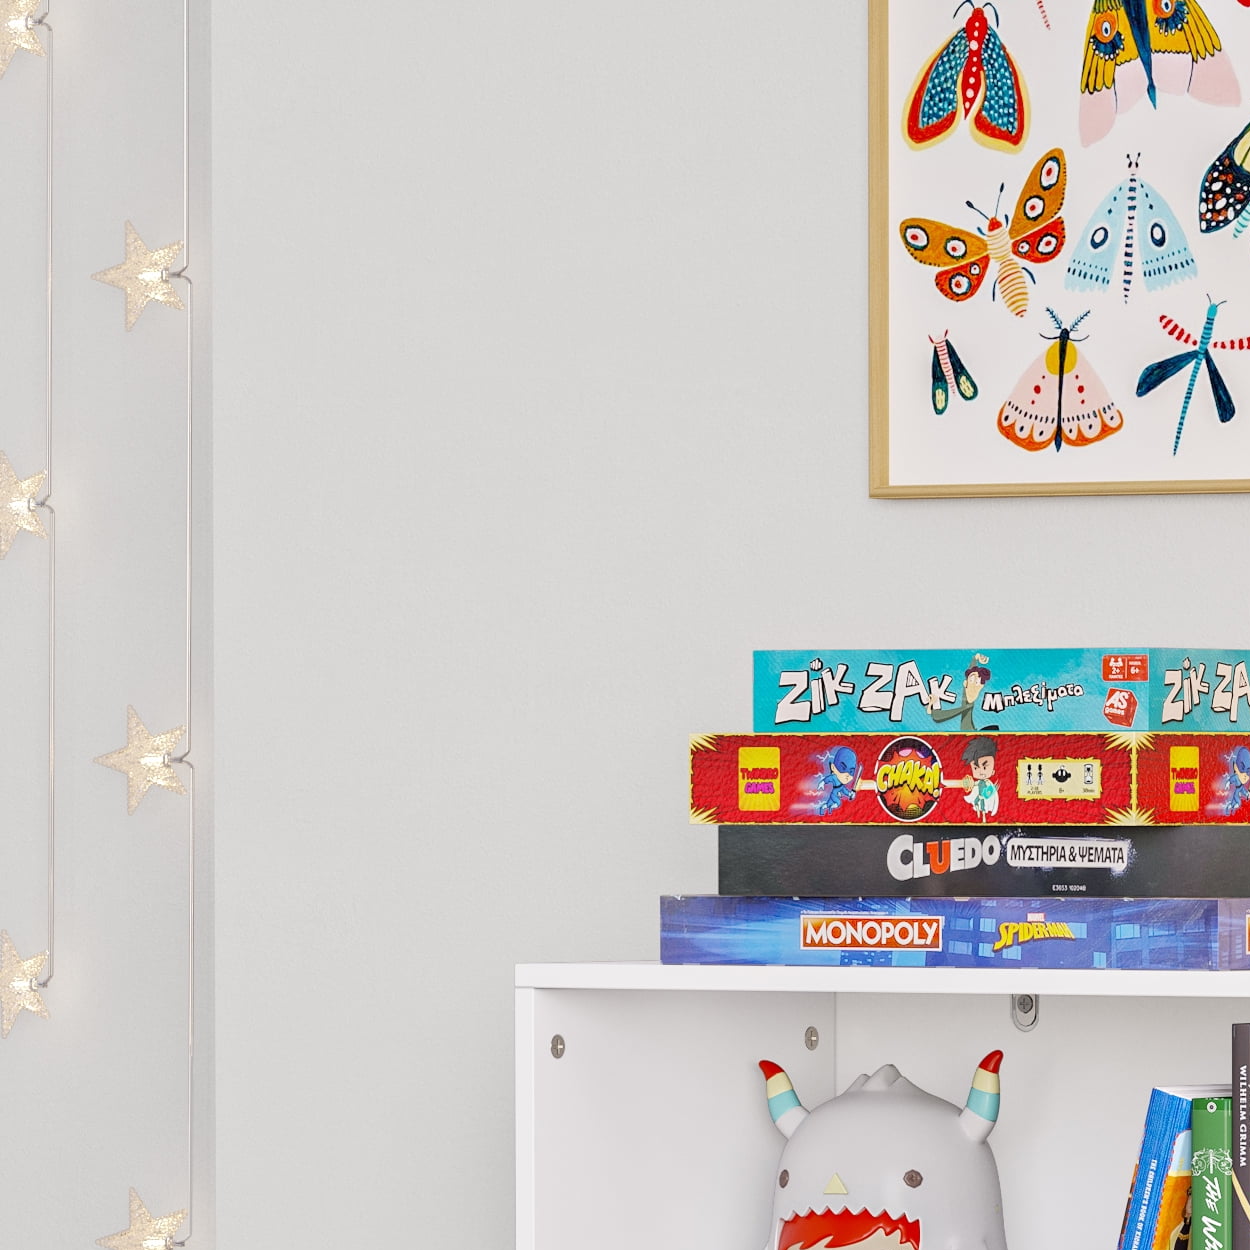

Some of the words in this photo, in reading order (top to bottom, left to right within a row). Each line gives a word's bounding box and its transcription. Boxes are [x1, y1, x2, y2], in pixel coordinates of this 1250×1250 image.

[1105, 691, 1129, 709] AS
[744, 782, 775, 794] GAMES
[876, 759, 941, 798] CHAKA!
[887, 834, 1000, 881] CLUEDO
[1010, 844, 1067, 862] ΜΥΣΤΗΡΙΑ
[1068, 845, 1077, 863] &
[1078, 845, 1125, 864] ΨΕΜΑΤΑ
[805, 920, 938, 945] MONOPOLY
[1239, 1065, 1247, 1121] WILHELM
[1239, 1123, 1247, 1167] GRIMM
[1202, 1175, 1222, 1214] THE
